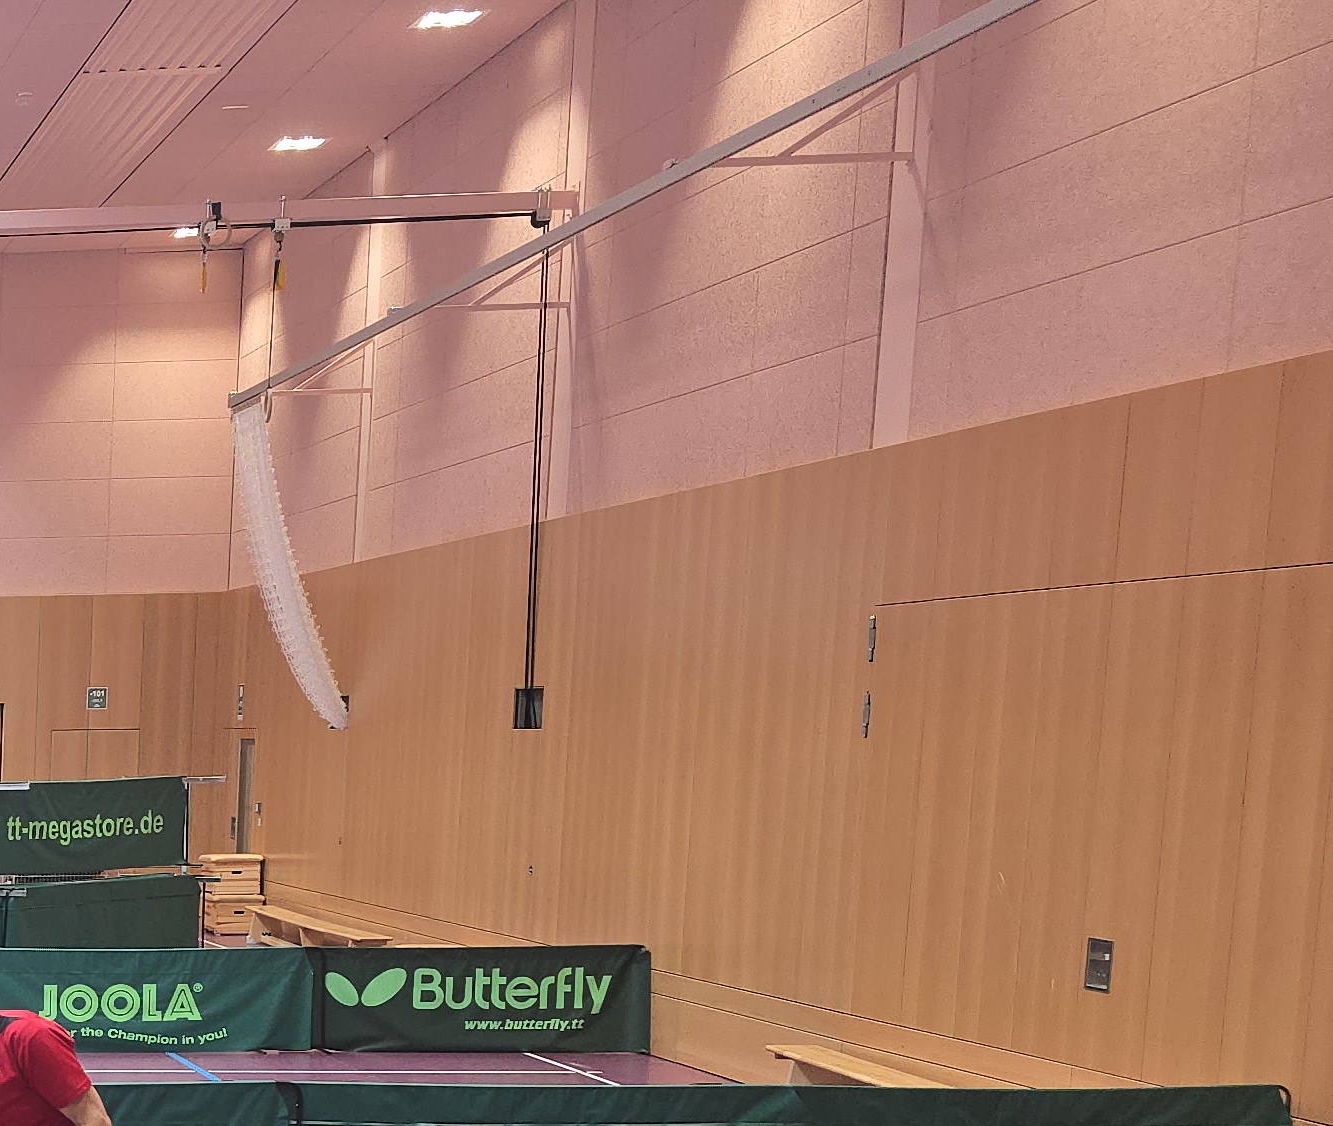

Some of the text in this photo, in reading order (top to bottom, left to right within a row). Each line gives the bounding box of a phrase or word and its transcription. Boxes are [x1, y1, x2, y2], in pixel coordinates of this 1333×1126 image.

[7, 810, 164, 846] tt-megastore.de
[413, 967, 613, 1015] Butterfly
[81, 1026, 104, 1038] the
[108, 1028, 178, 1045] Champion
[182, 1034, 195, 1044] in
[198, 1027, 228, 1045] you!
[464, 1018, 585, 1033] www.butterfly.tt
